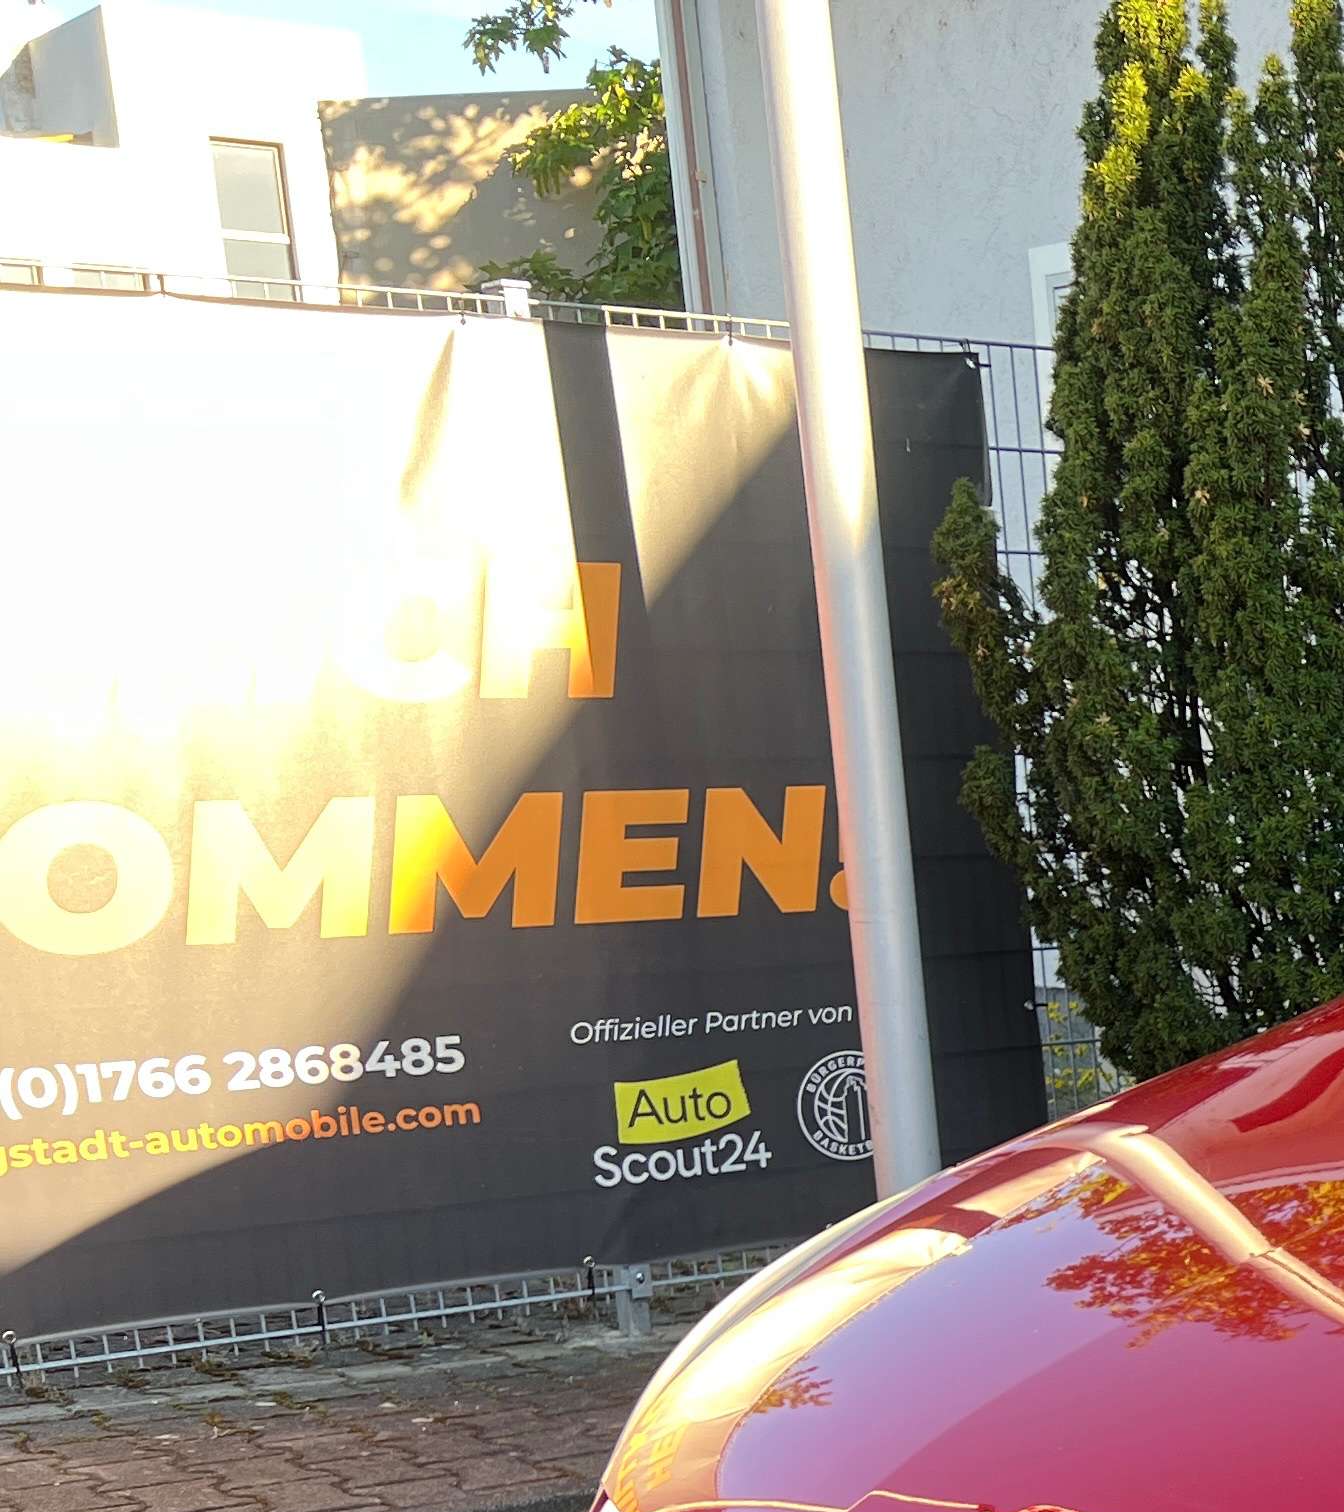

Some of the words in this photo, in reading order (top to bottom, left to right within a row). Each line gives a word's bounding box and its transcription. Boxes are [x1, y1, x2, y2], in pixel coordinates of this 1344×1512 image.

[570, 1016, 698, 1045] Offizieller
[705, 1008, 802, 1035] Partner
[808, 1004, 853, 1026] von
[223, 1034, 466, 1092] 2868485
[628, 1087, 733, 1128] Auto
[593, 1130, 772, 1188] Scout24
